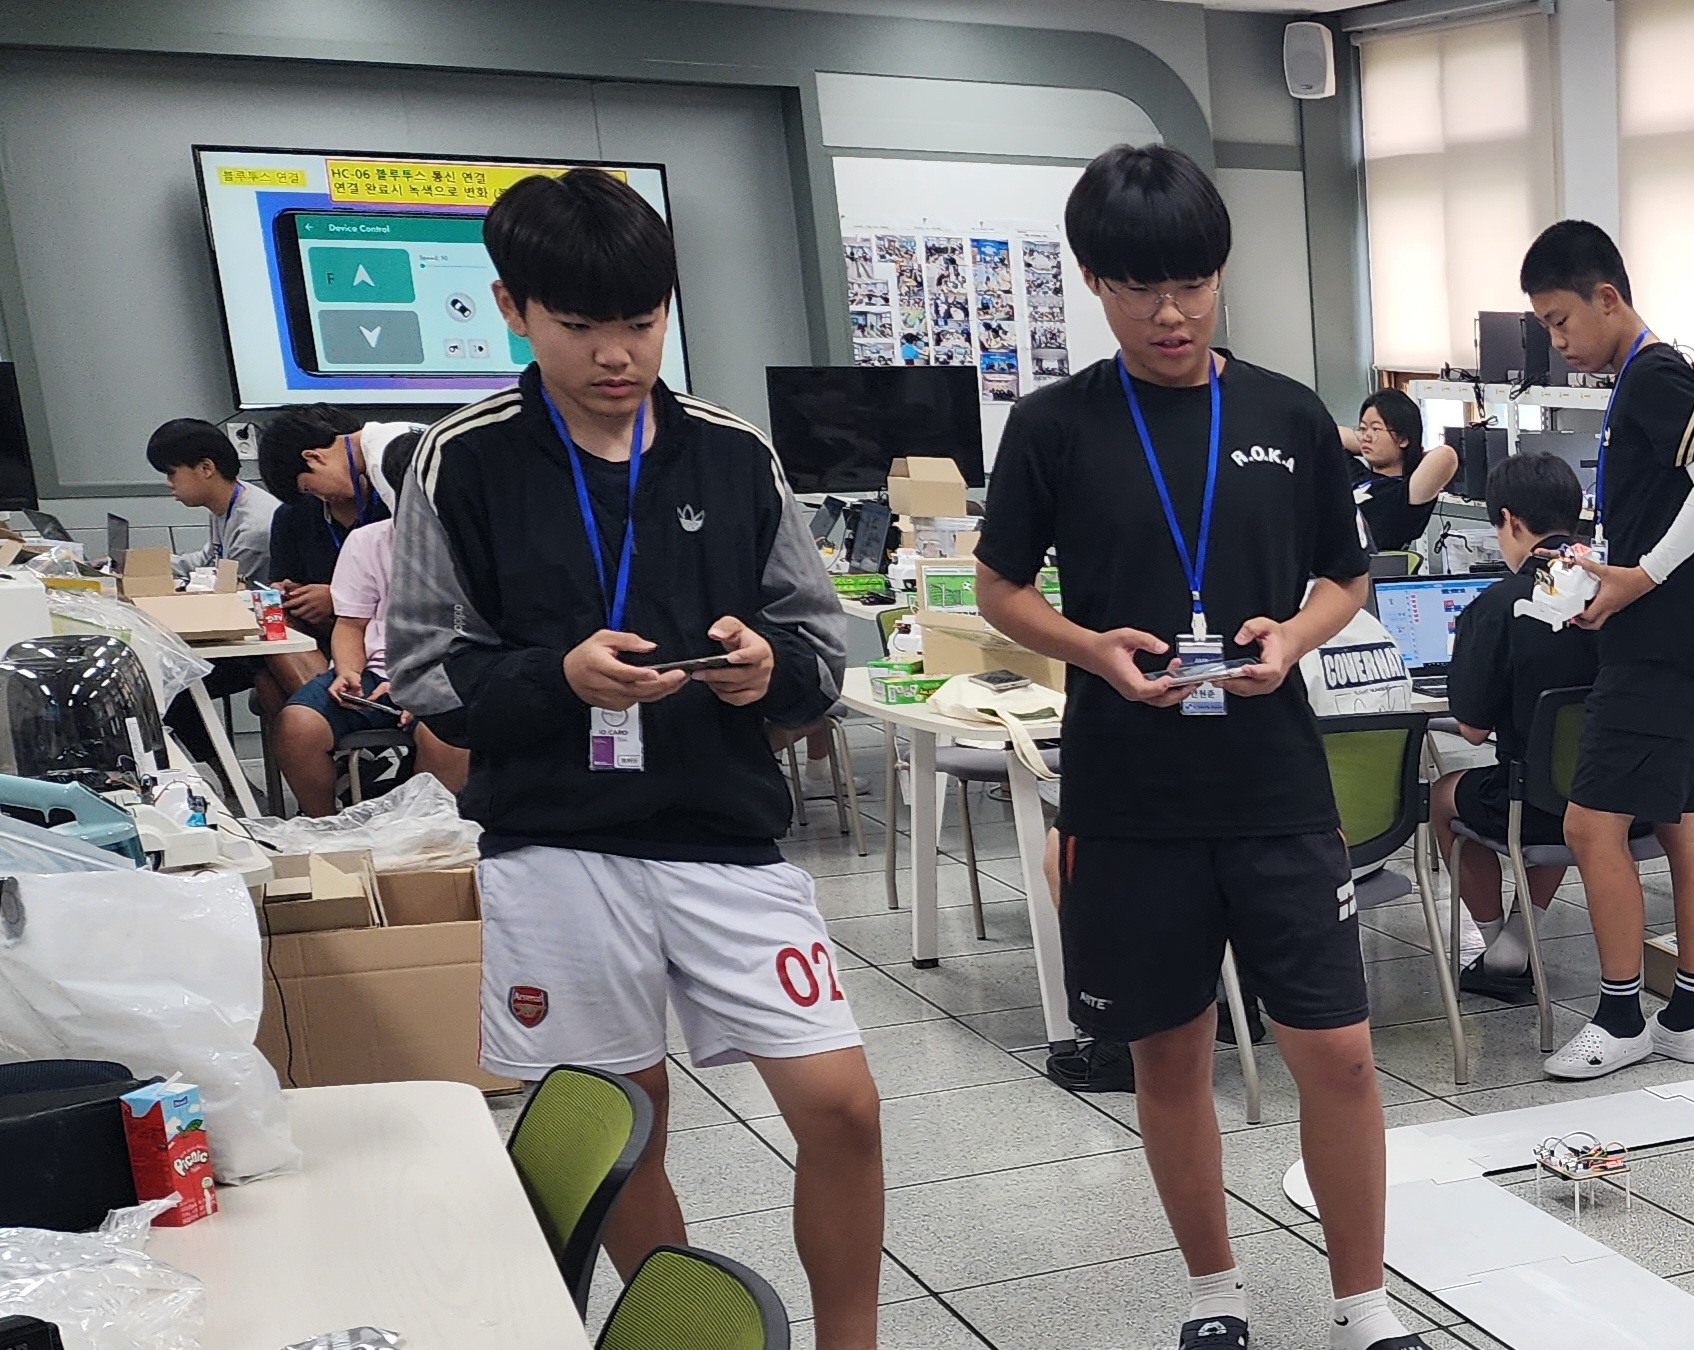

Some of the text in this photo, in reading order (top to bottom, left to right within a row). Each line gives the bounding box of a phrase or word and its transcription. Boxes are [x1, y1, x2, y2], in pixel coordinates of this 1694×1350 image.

[223, 170, 299, 184] 블루투스 연결
[331, 168, 486, 185] HC-06 블루투스 통신 연결
[334, 182, 359, 195] 연결
[365, 183, 403, 196] 완료시
[409, 185, 458, 198] 녹색으로
[464, 187, 488, 199] 변화
[328, 224, 390, 234] Device Control
[326, 272, 335, 284] F
[1230, 445, 1295, 474] R.O.K.A
[775, 941, 845, 1008] 02
[173, 1149, 209, 1177] Picnic
